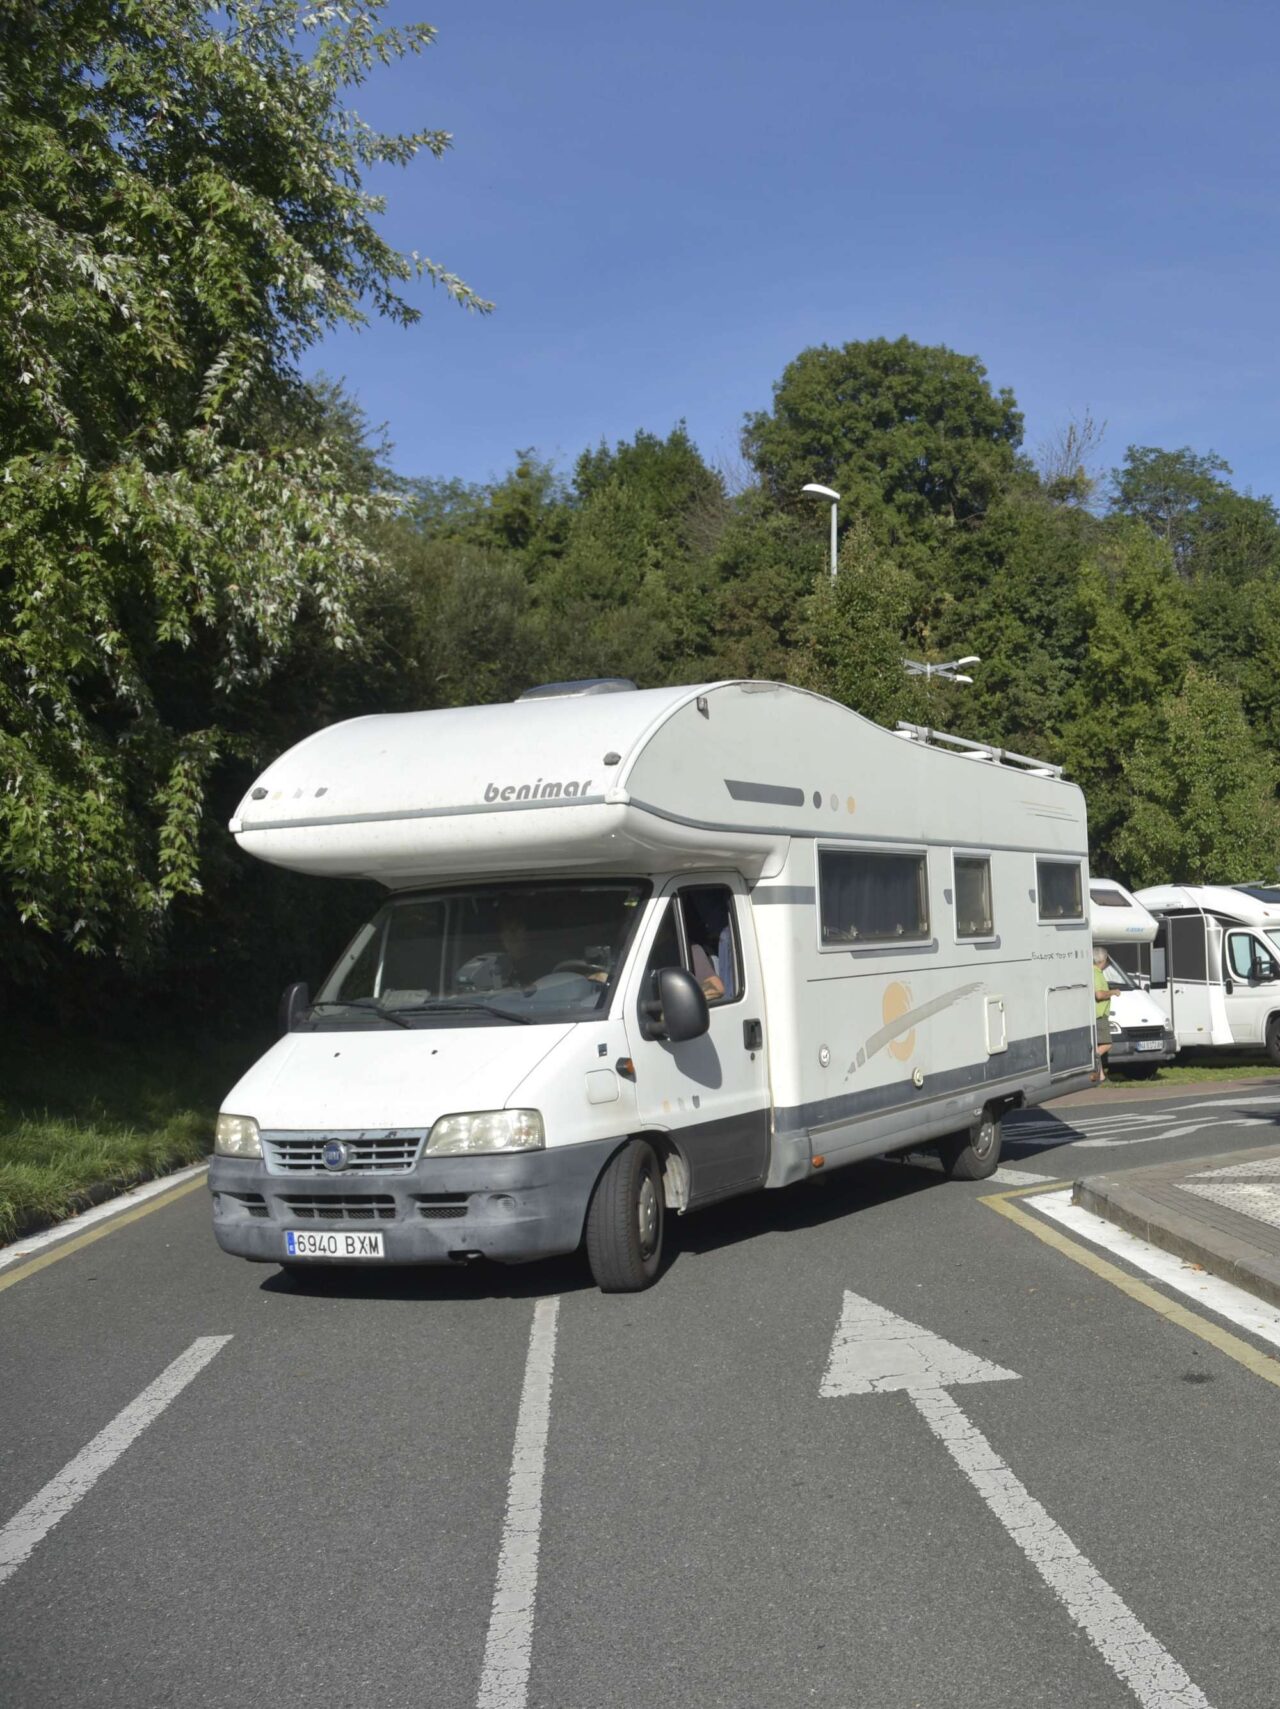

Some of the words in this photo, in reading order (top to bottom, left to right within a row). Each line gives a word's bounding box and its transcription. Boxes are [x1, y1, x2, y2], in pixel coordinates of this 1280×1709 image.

[483, 777, 593, 803] benimar
[297, 1234, 337, 1254] 6940
[345, 1235, 379, 1254] BXM
